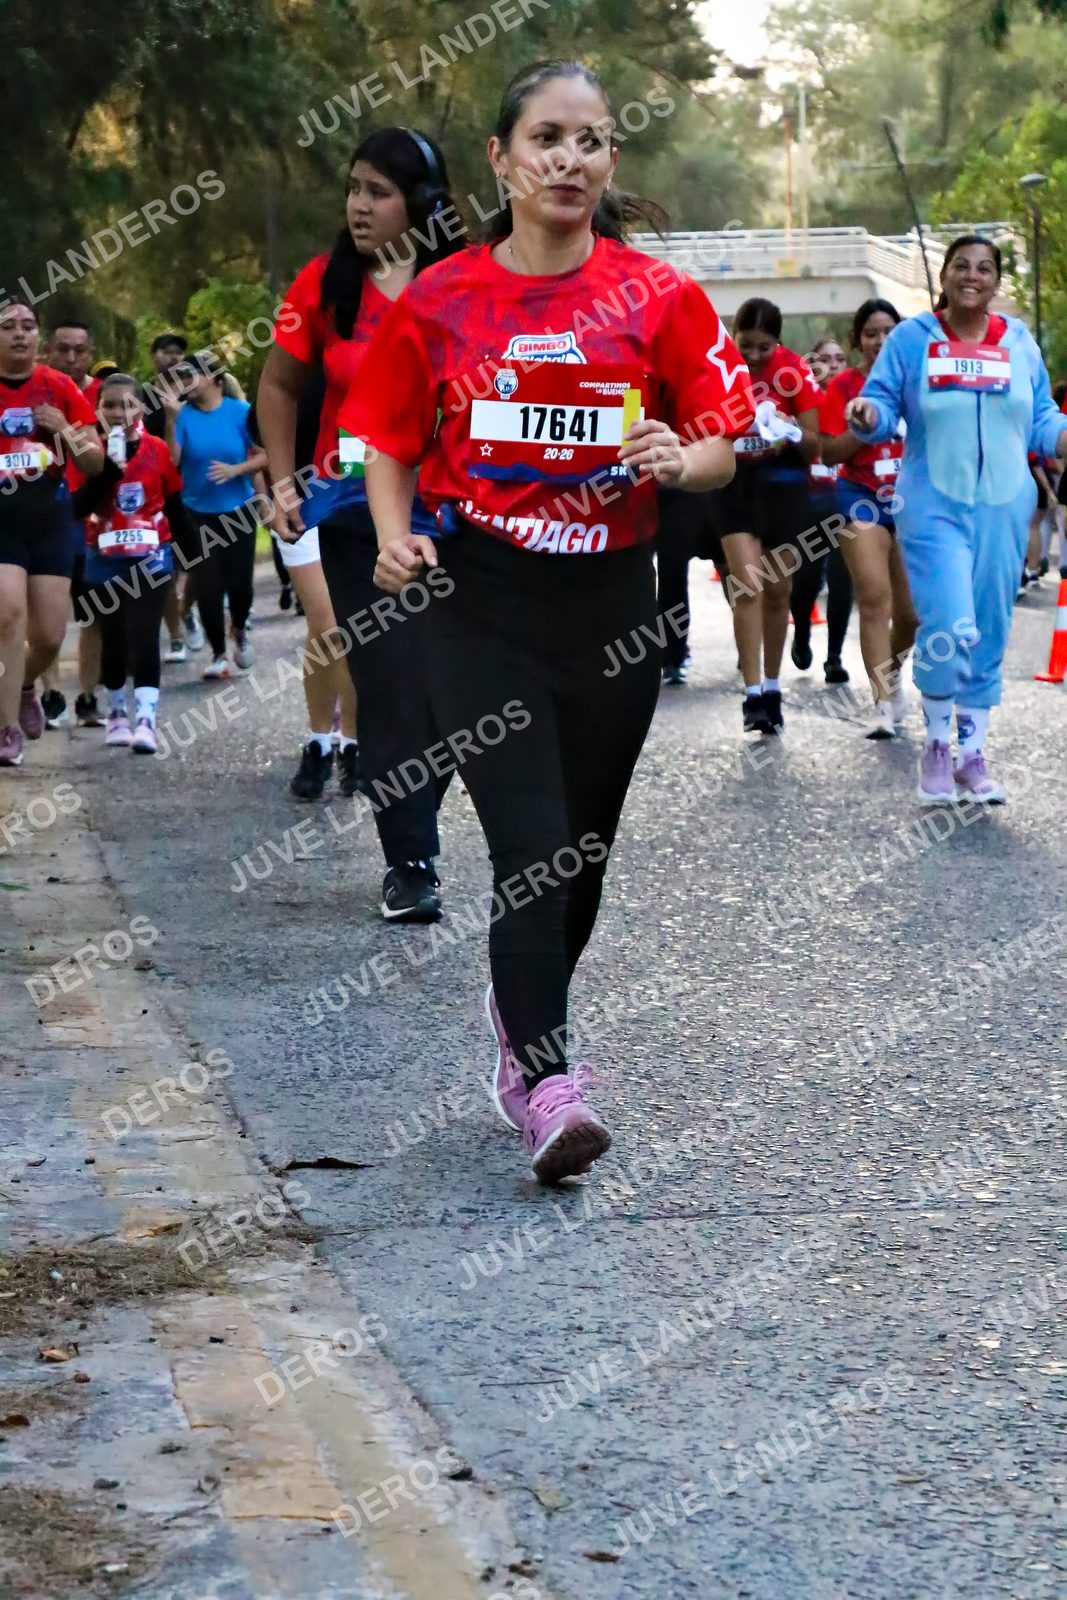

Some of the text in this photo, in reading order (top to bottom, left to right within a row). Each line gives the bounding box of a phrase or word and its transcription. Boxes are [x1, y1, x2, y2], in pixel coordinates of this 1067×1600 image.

[518, 341, 566, 352] BIMBO
[954, 360, 983, 374] 1913
[520, 406, 598, 442] 17641
[4, 454, 31, 467] 3017
[610, 466, 627, 476] 5K
[115, 530, 143, 543] 2255
